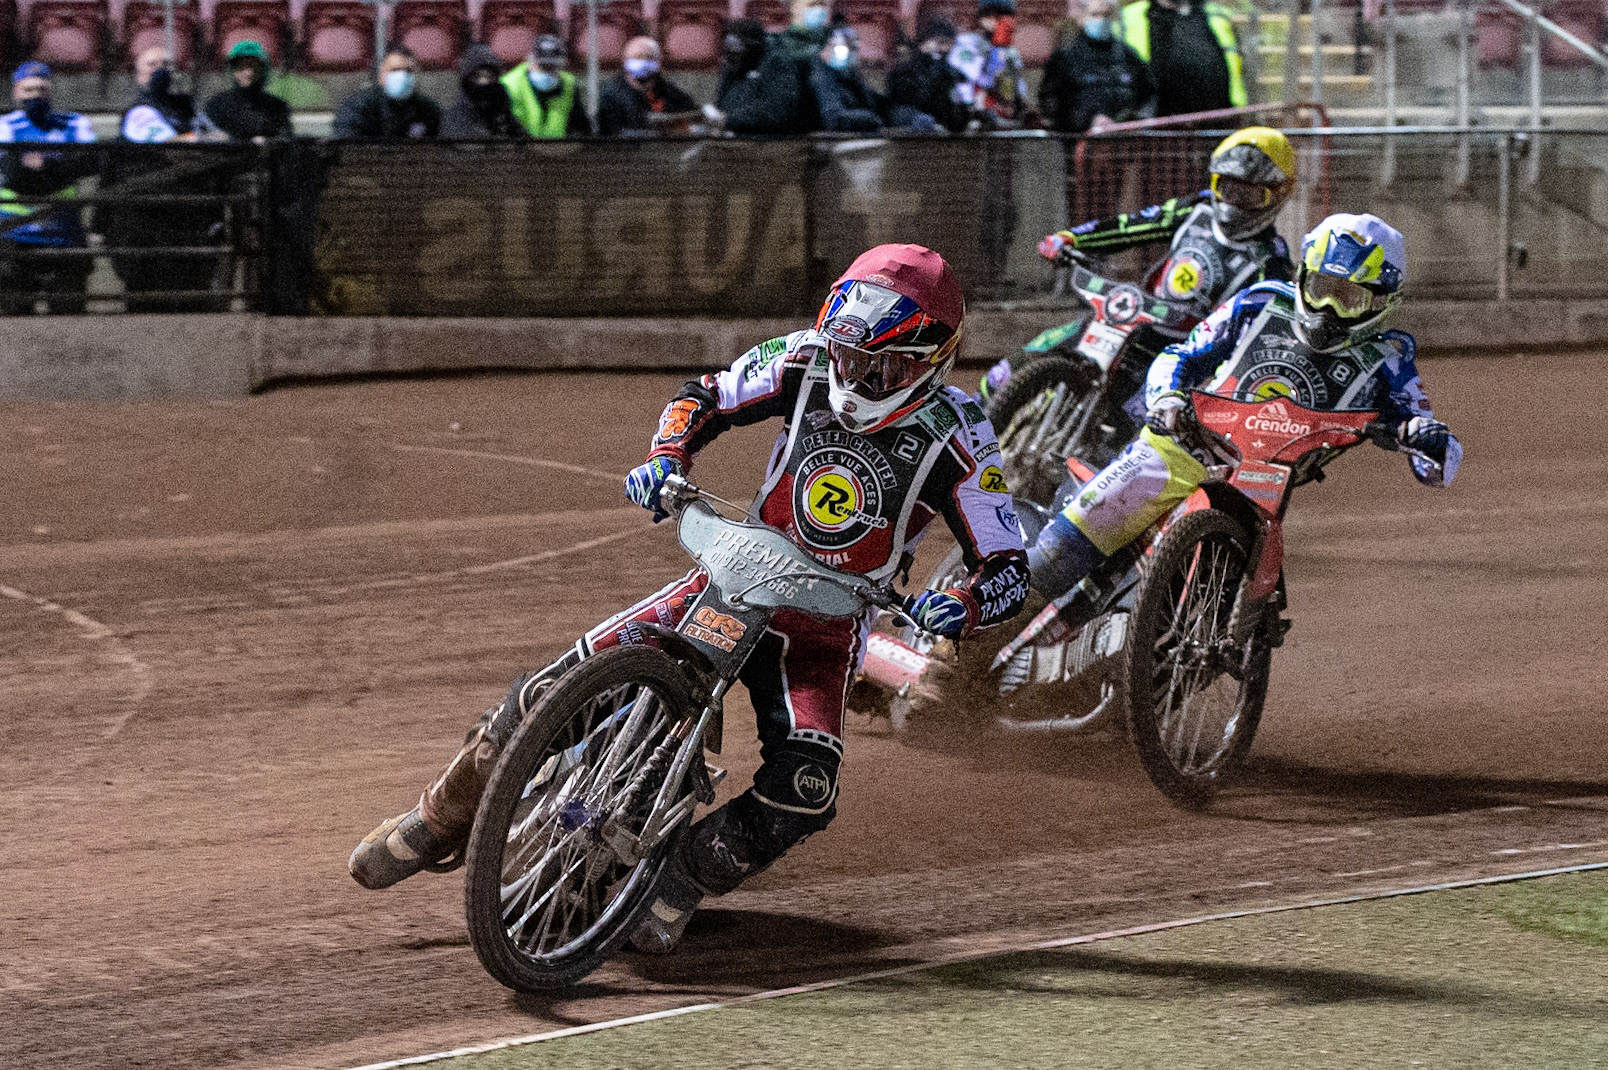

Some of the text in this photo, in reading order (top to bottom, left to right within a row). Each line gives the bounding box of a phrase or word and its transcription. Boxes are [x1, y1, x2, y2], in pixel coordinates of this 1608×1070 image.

[1332, 363, 1351, 382] 8
[1245, 415, 1311, 435] Crendon
[802, 430, 898, 490] PETER CRAVEN
[900, 434, 919, 460] 2
[803, 453, 877, 506] BELLE VUE ACES
[815, 481, 888, 529] Rentruck
[714, 529, 819, 591] PREMIER
[684, 624, 737, 652] FILTRATION
